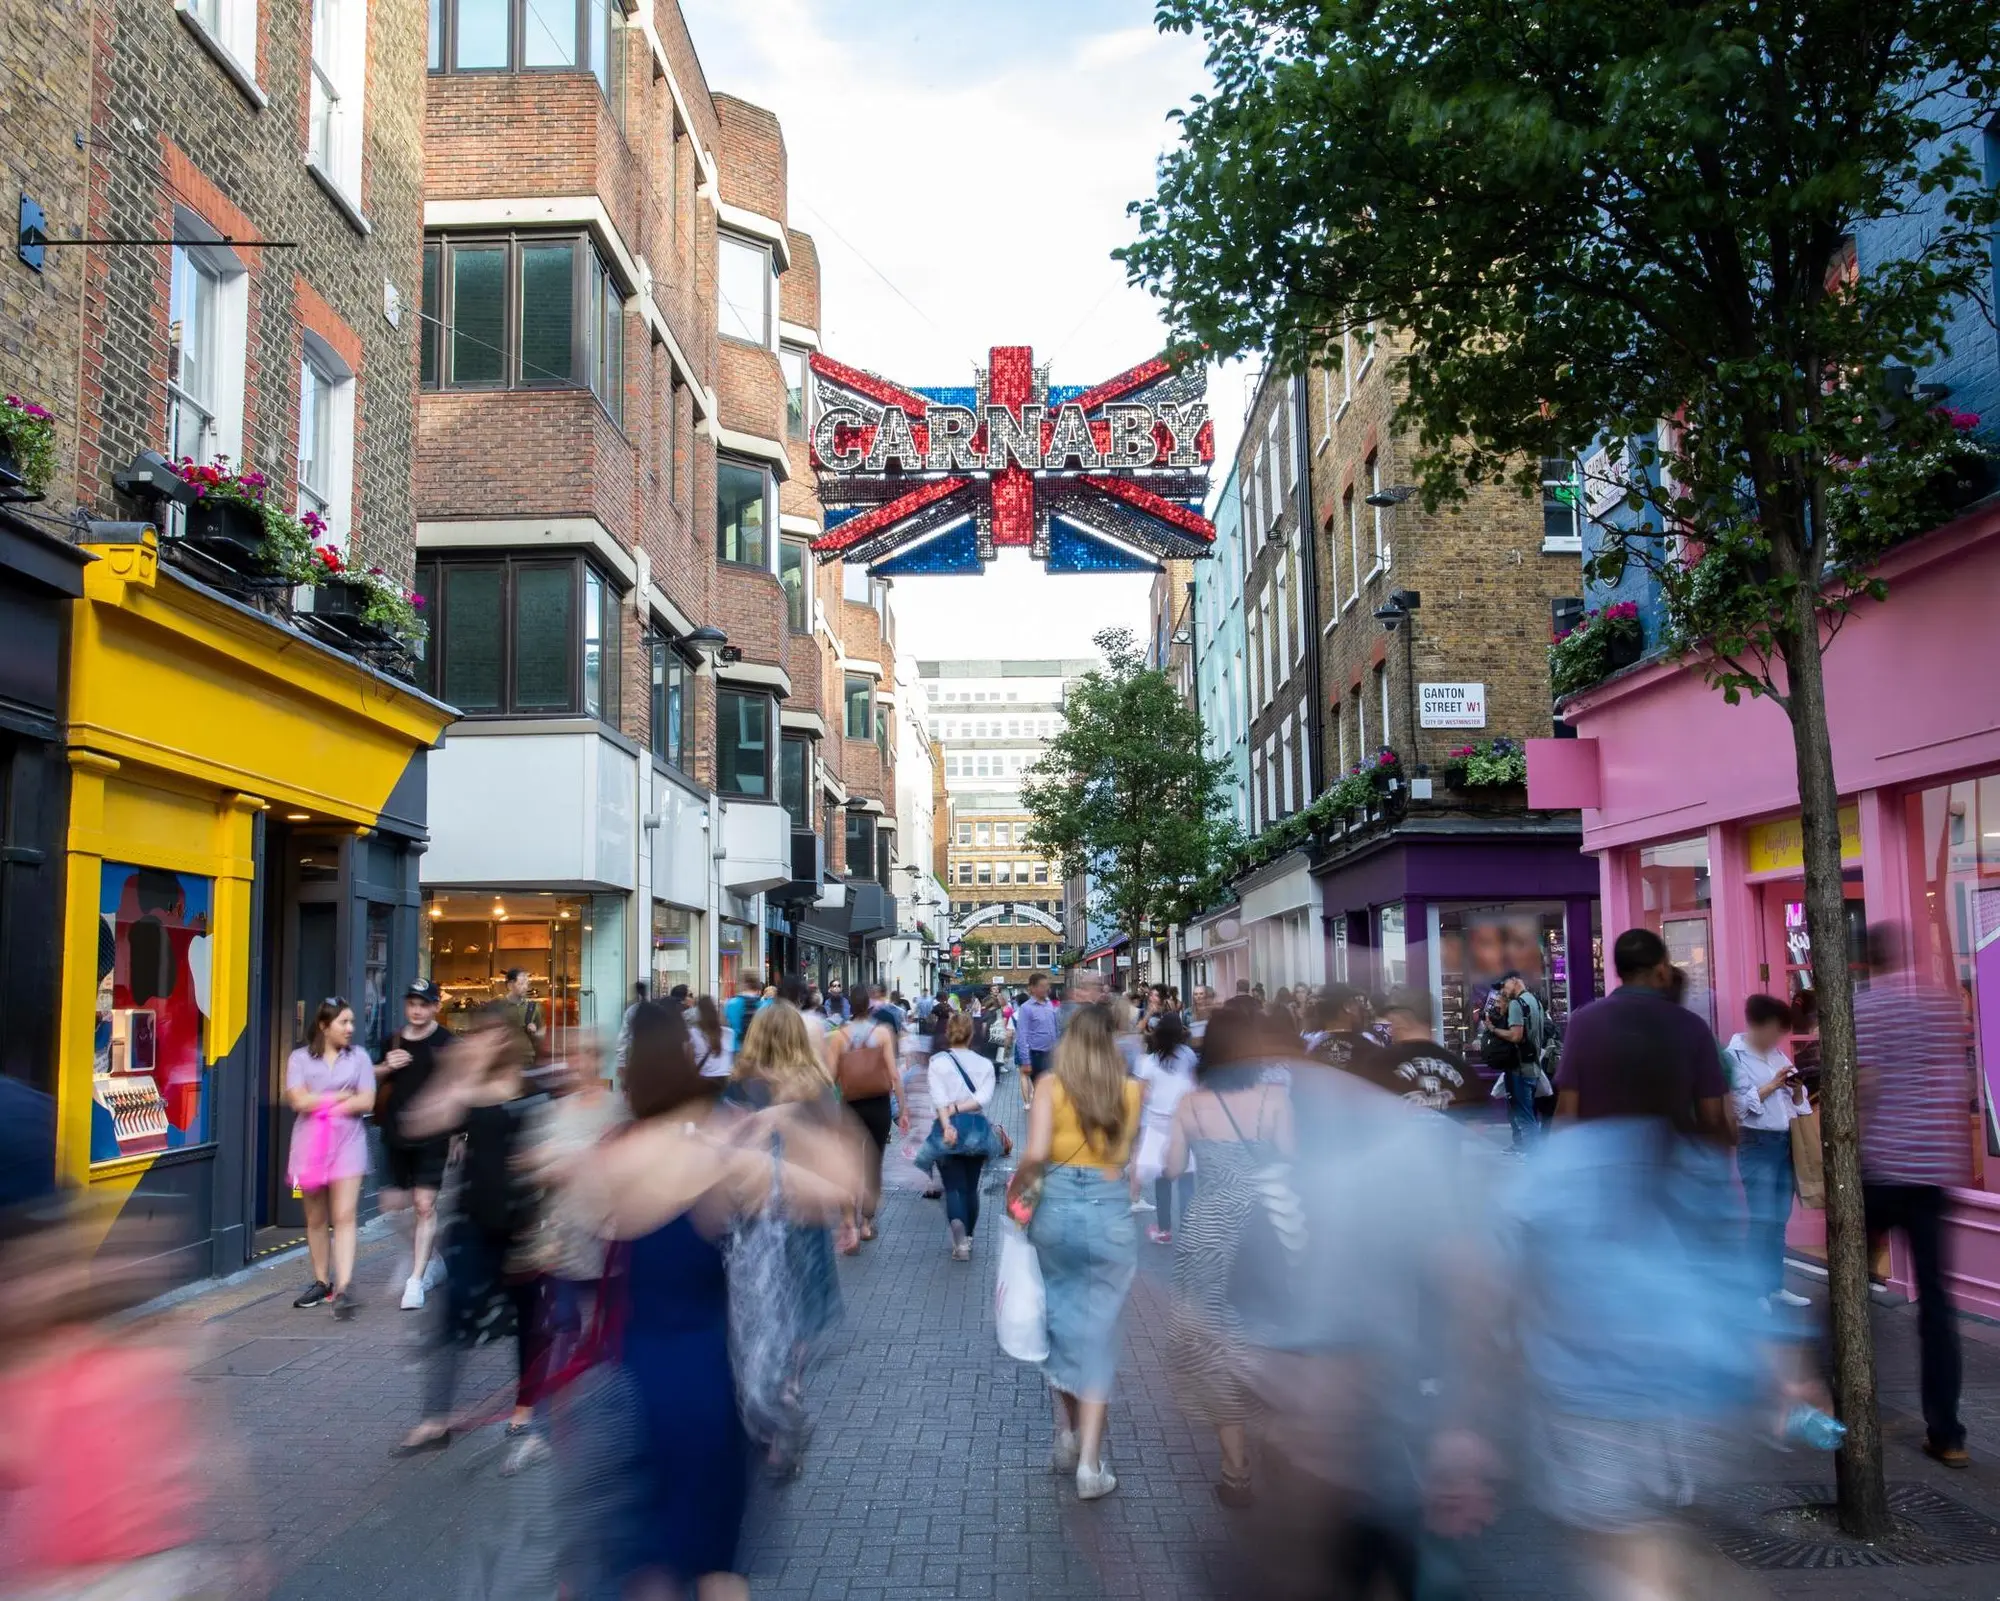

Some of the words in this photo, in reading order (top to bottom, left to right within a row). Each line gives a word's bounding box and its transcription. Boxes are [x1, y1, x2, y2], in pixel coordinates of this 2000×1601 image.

[814, 402, 1212, 470] CARNABY
[1424, 687, 1465, 698] GANTON
[1425, 702, 1462, 712] STREET
[1466, 702, 1481, 712] W1
